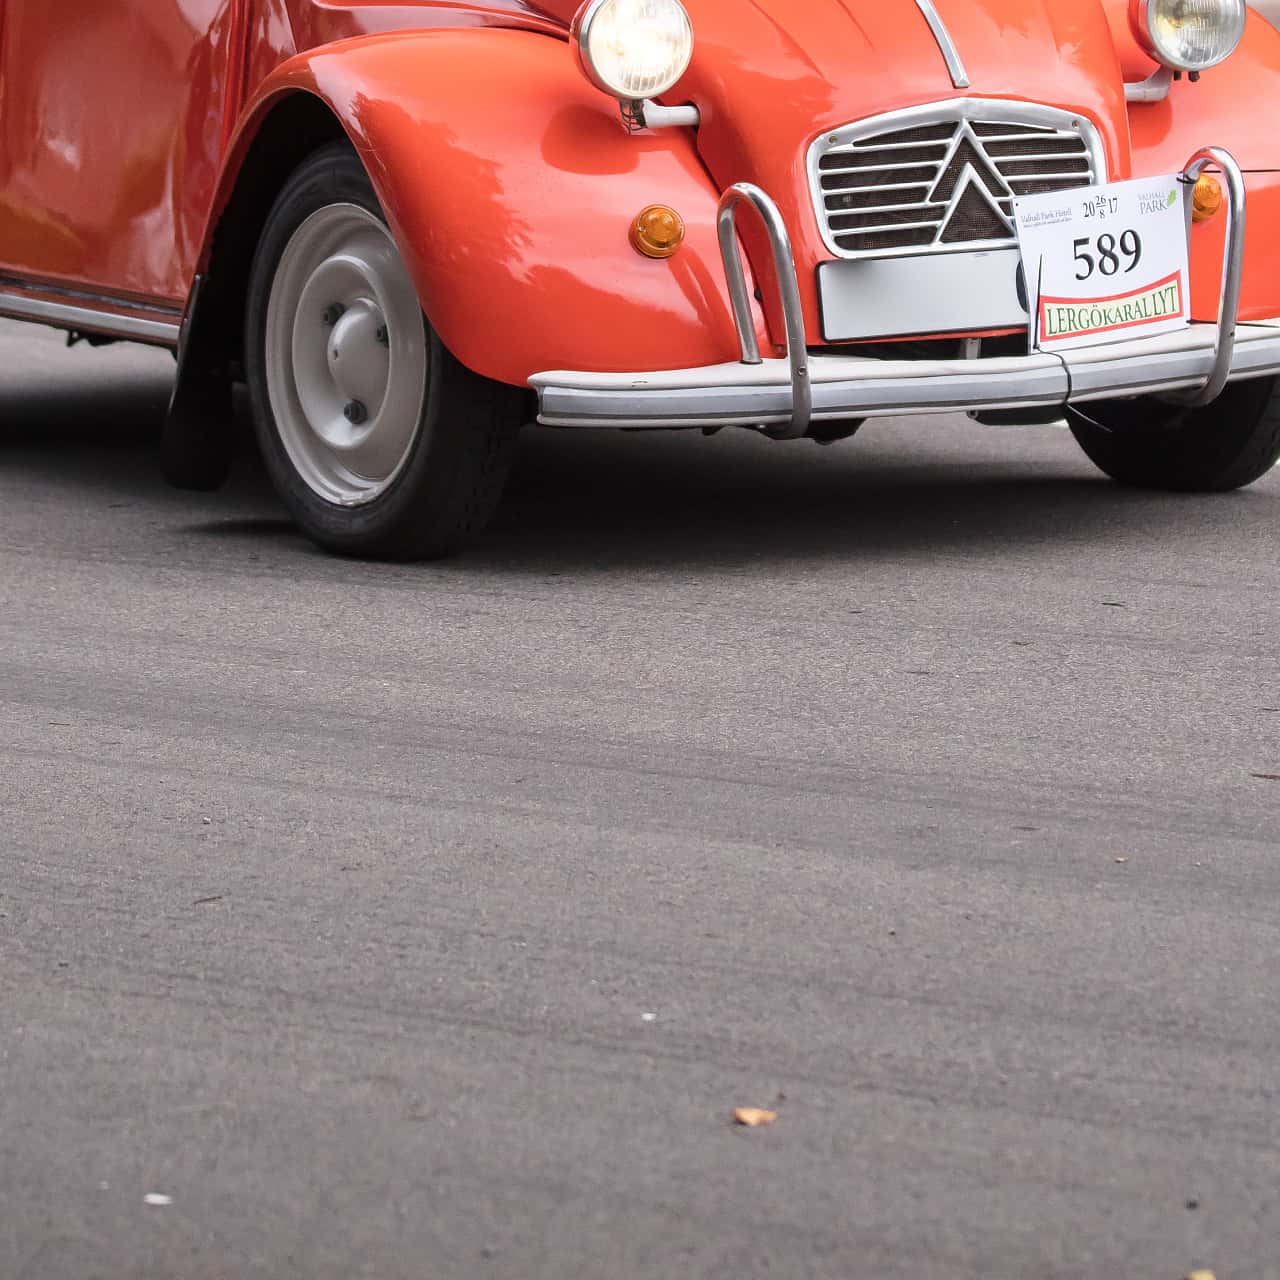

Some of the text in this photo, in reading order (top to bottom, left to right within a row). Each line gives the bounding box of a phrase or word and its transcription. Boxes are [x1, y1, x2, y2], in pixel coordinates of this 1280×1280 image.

[1140, 199, 1168, 215] PARK
[1073, 229, 1142, 281] 589
[1046, 285, 1177, 335] LERGÖKARALLYT
